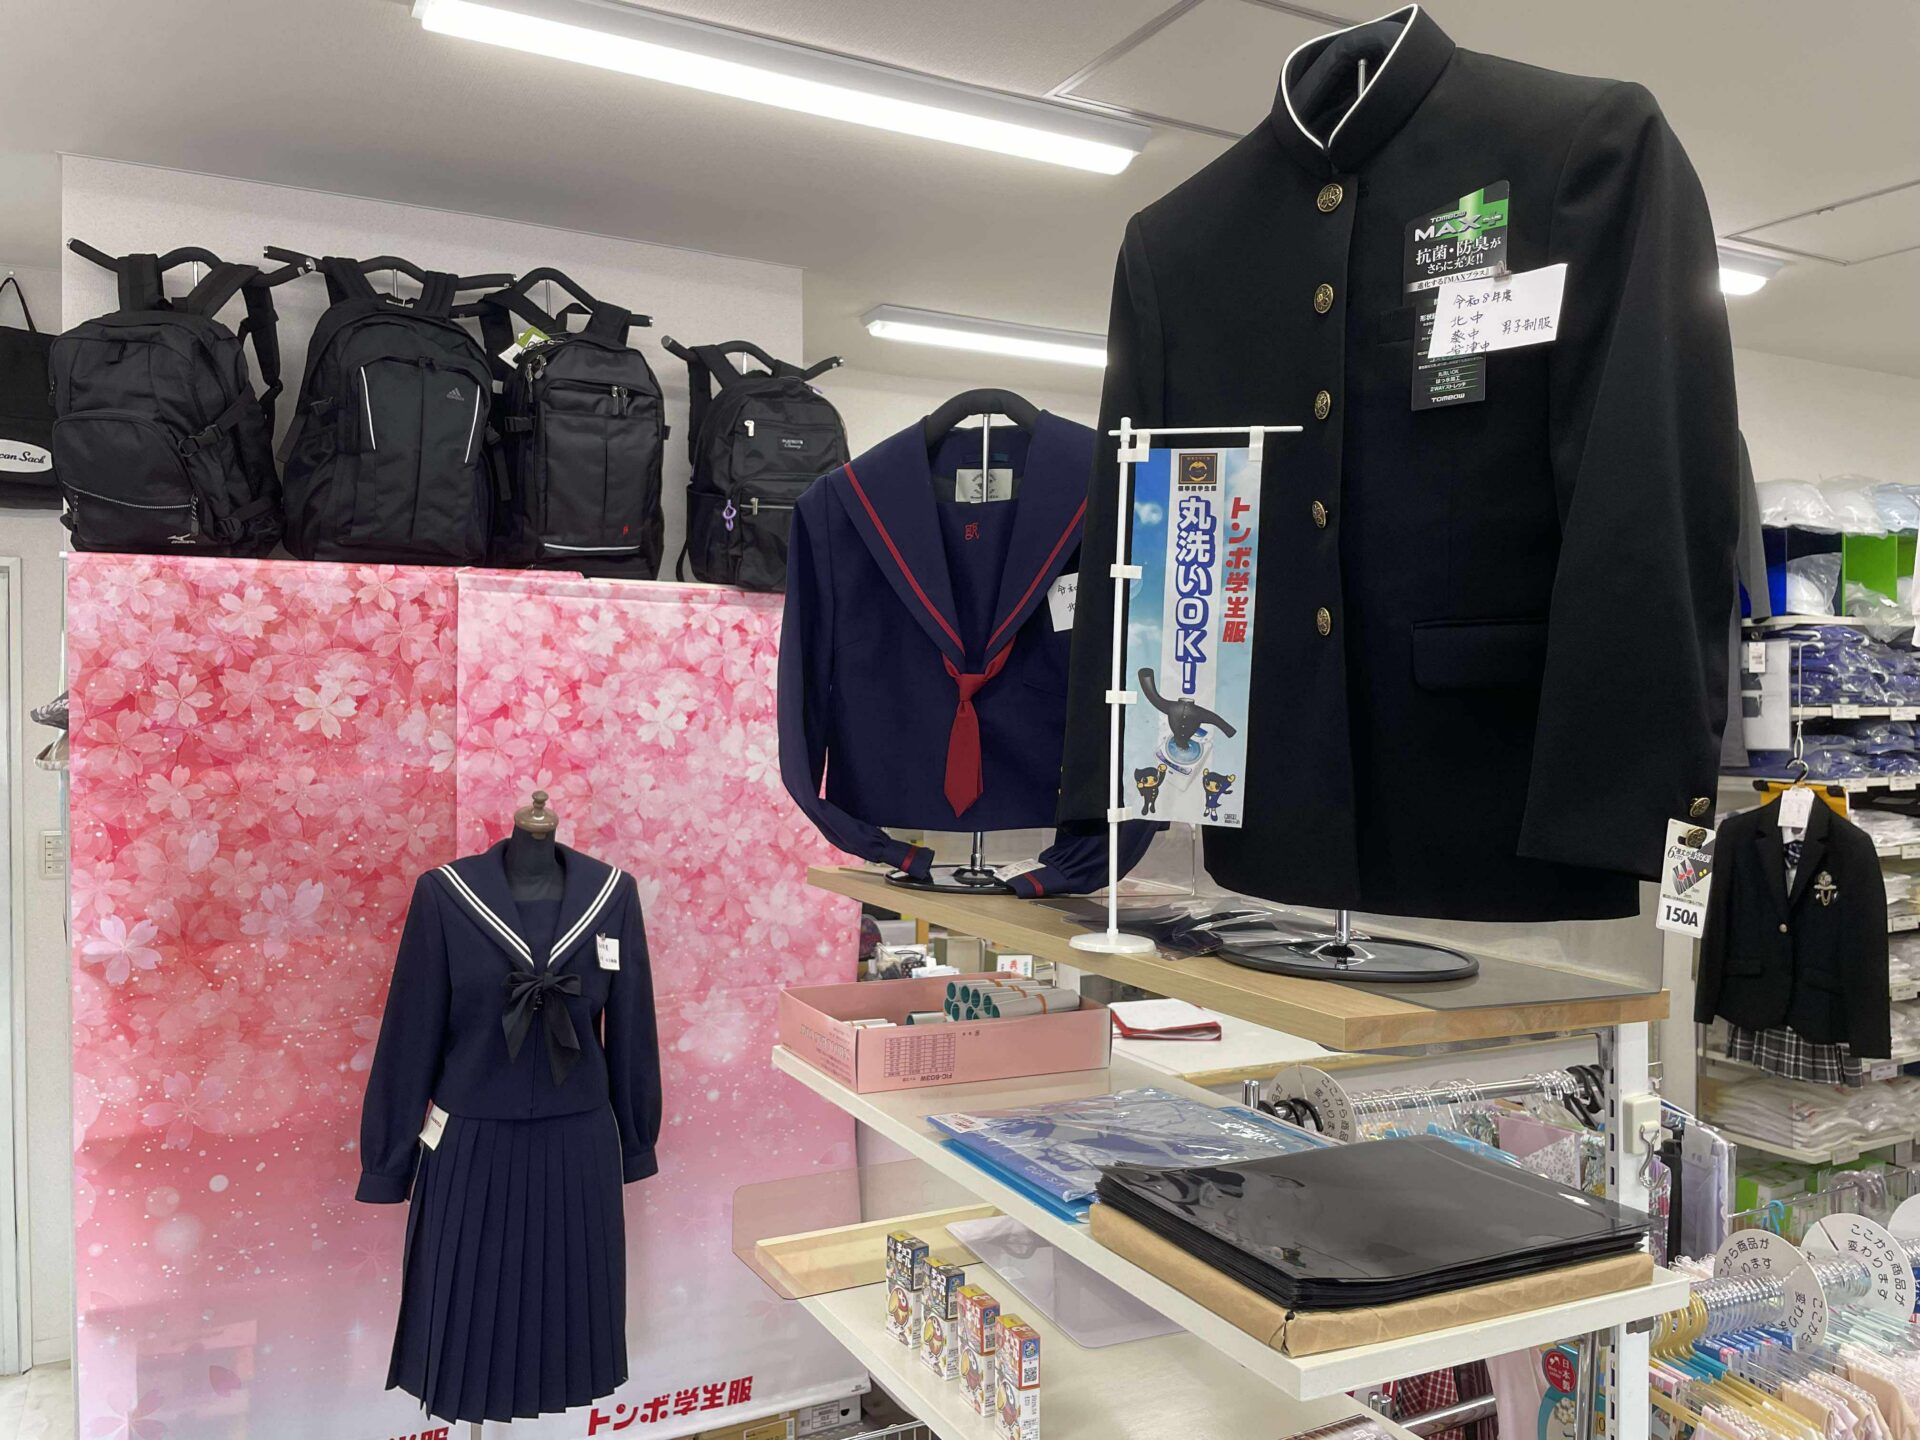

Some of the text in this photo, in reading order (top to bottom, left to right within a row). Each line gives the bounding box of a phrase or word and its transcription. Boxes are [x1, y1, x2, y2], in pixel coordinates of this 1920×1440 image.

[1414, 214, 1482, 242] MAX
[1415, 236, 1502, 266] 抗菌・防臭が
[1453, 288, 1513, 309] 令和8年度
[1501, 316, 1553, 336] 男子制服
[1430, 392, 1466, 403] TOMBOW
[18, 450, 47, 464] Sack
[1222, 496, 1252, 644] トンボ学生服
[1175, 495, 1217, 695] 丸洗いOK!
[1665, 904, 1699, 928] 150A
[1320, 1077, 1350, 1142] ここから商品
[1719, 1237, 1770, 1277] こから商品が
[1740, 1257, 1772, 1274] ります
[587, 1375, 754, 1437] トンボ学生服
